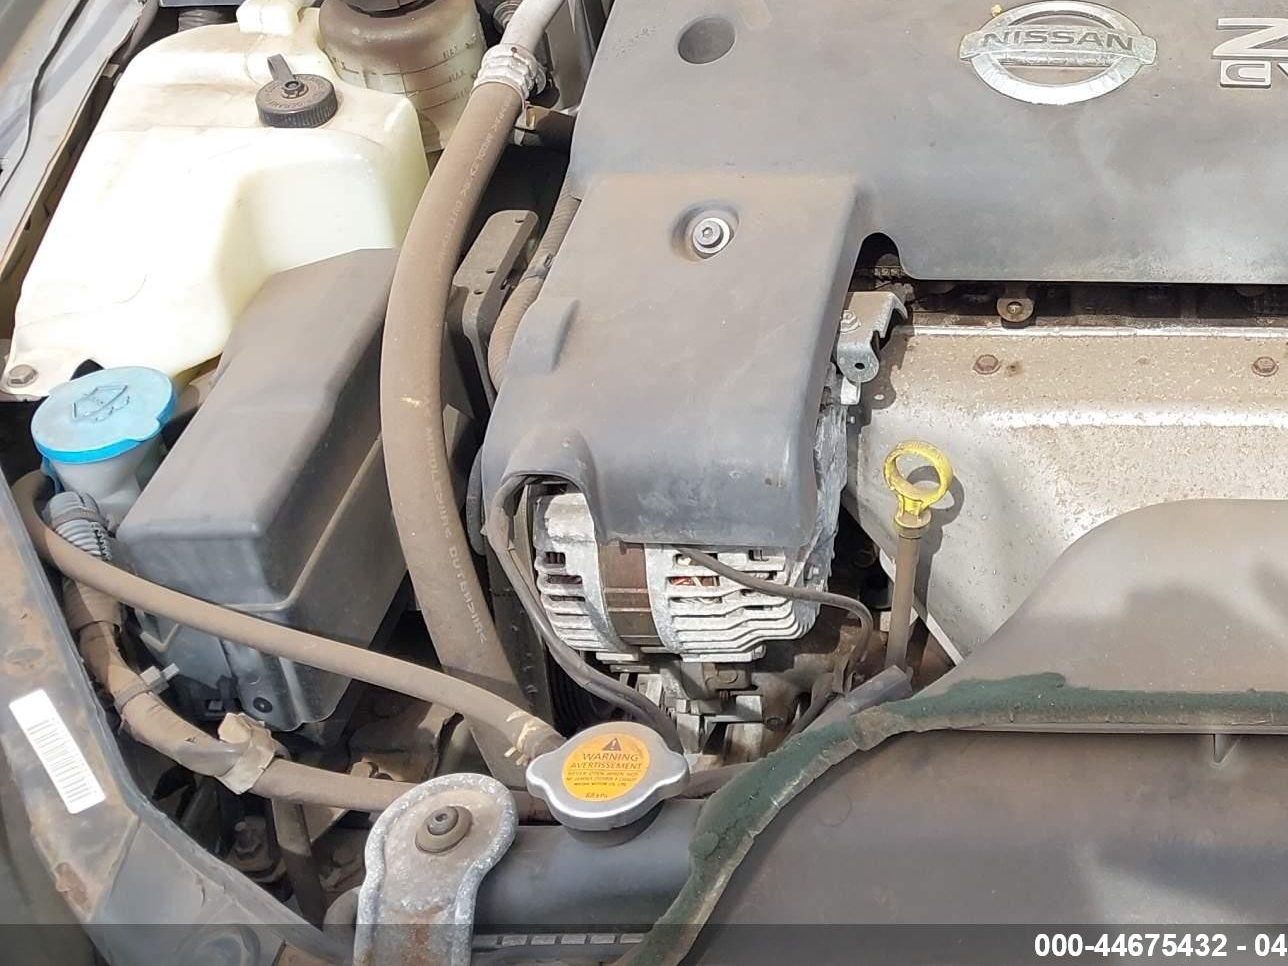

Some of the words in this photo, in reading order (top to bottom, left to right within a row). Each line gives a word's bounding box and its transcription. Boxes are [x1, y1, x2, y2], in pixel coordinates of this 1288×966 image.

[982, 31, 1134, 51] NISSAN
[583, 753, 639, 762] WARNING
[570, 762, 642, 770] AVERTISSEMENT
